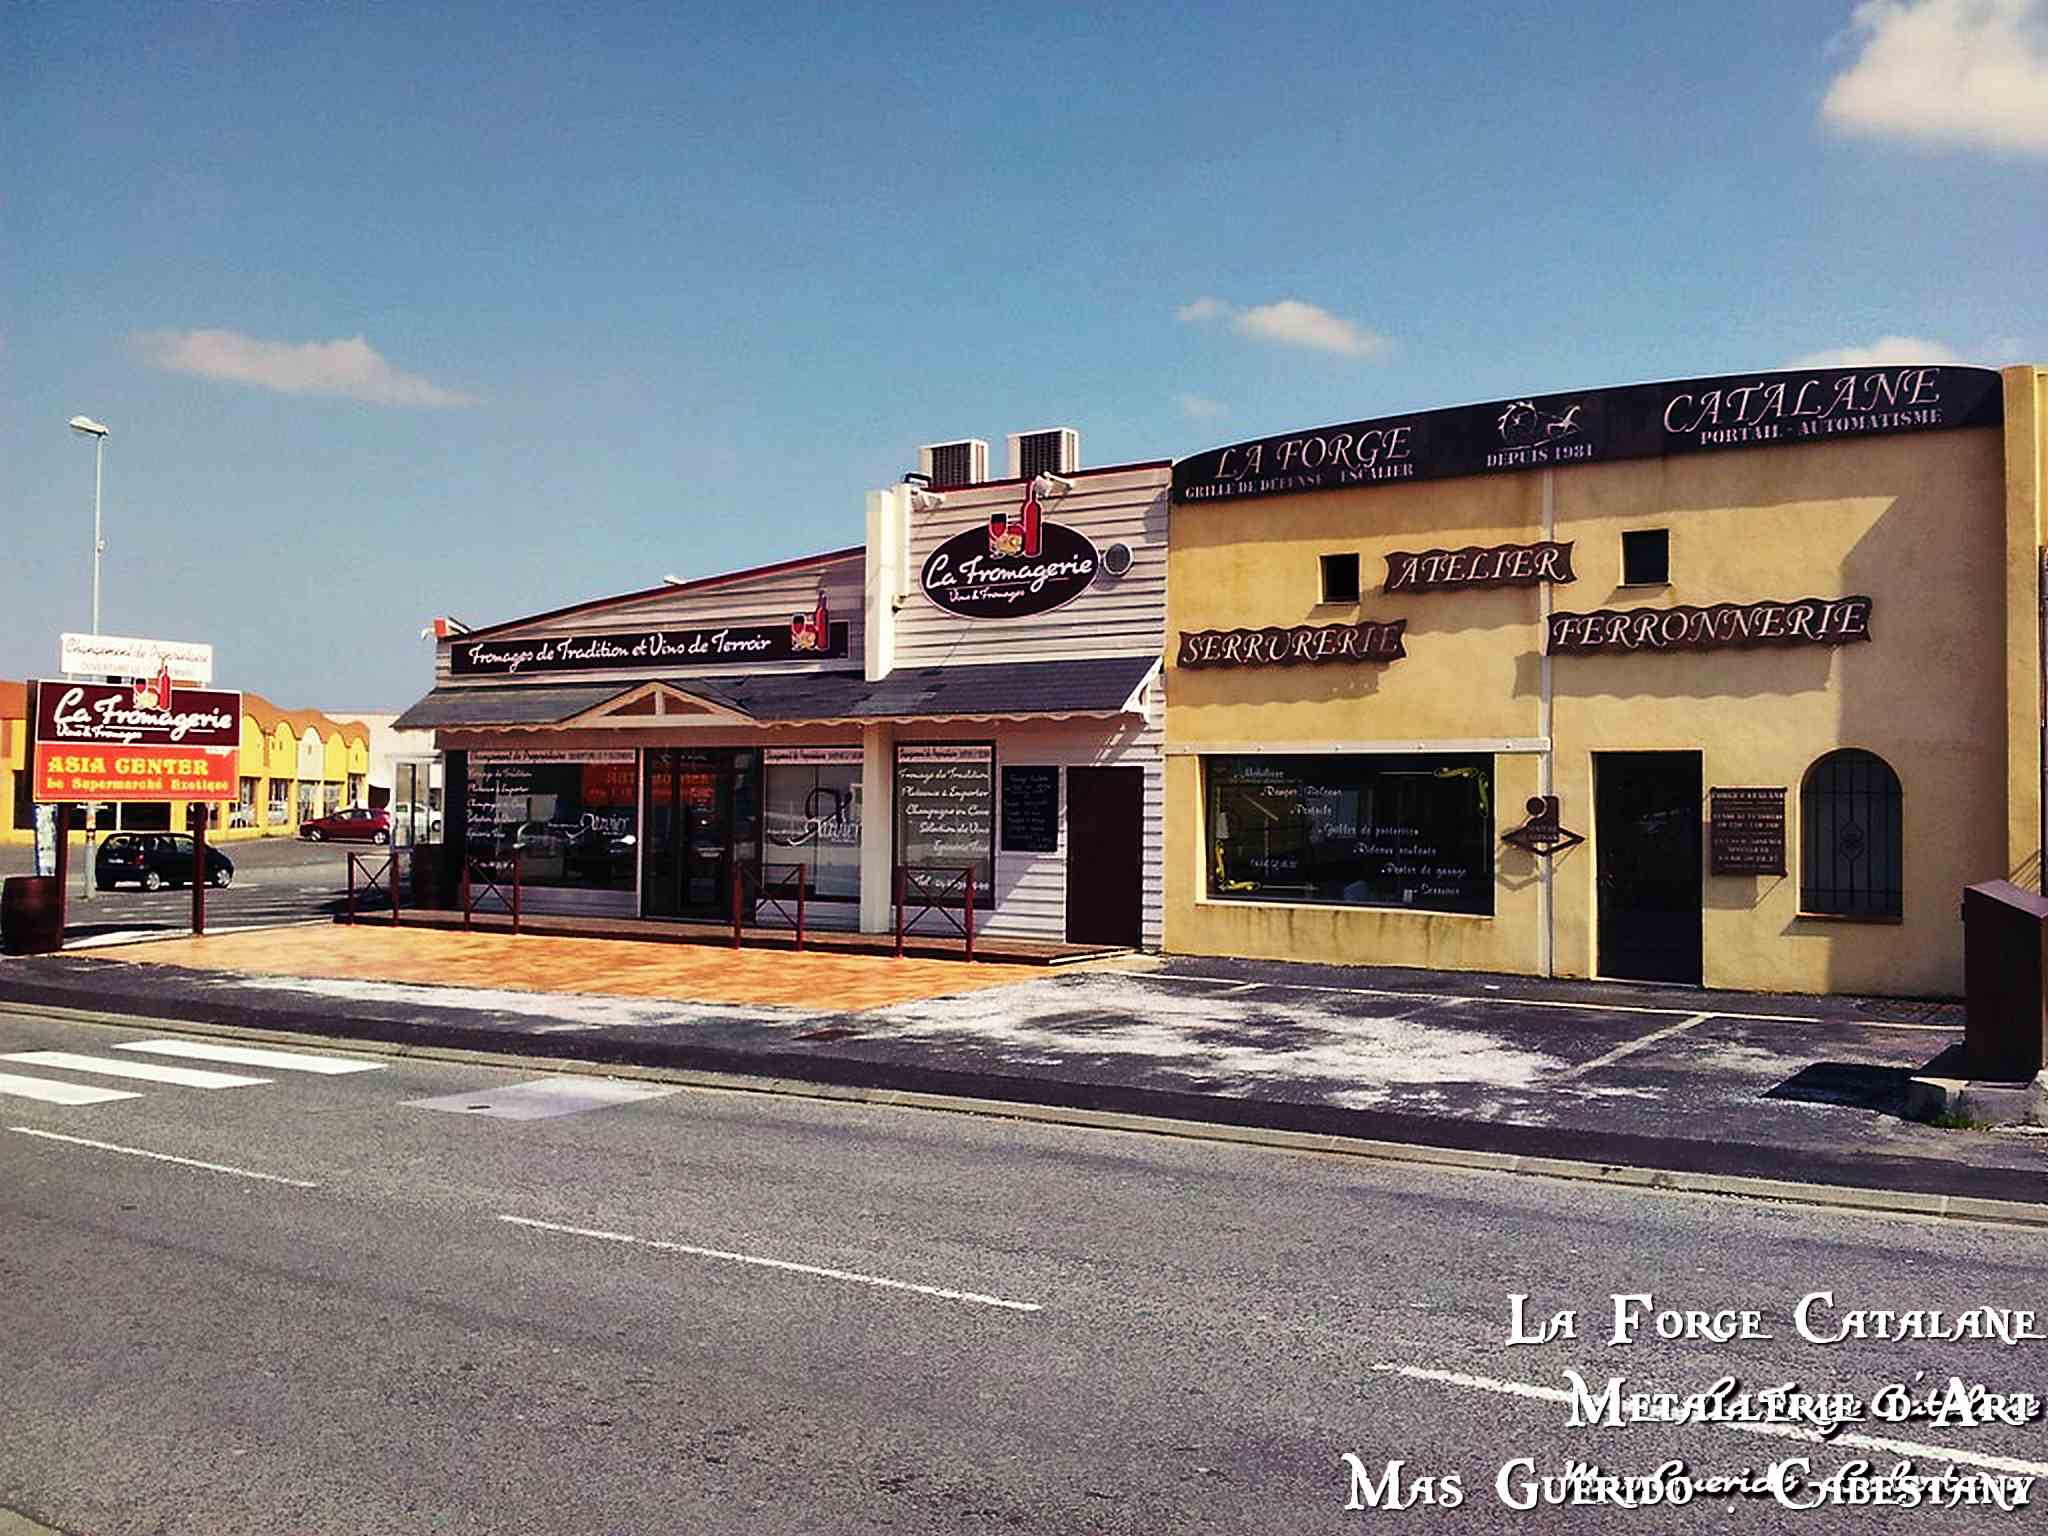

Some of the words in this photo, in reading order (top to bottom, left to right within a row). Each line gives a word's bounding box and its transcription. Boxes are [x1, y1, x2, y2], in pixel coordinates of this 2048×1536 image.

[1664, 367, 1941, 434] CATALANE
[1700, 424, 1783, 445] PORTAIL
[1799, 409, 1943, 436] AUTOMATISME
[1215, 444, 1264, 481] LA
[1276, 426, 1413, 471] FORGE
[1487, 448, 1549, 467] DEPUIS
[1555, 443, 1593, 460] 1981
[1185, 482, 1232, 498] GRILLE
[1238, 481, 1255, 494] DE
[1340, 463, 1414, 483] ESCALIER
[925, 554, 957, 589] La
[959, 554, 1093, 592] Fromagerie
[1393, 546, 1566, 590] ATELIER
[1182, 623, 1399, 665] SERRURERIE
[1552, 602, 1866, 649] FERRONNERIE
[468, 643, 534, 672] Fromages
[536, 642, 555, 662] de
[557, 637, 629, 660] Tradition
[632, 640, 648, 656] et
[649, 632, 685, 656] Vins
[688, 634, 709, 654] de
[711, 629, 772, 653] Terroir
[53, 687, 93, 723] La
[93, 694, 233, 742] Fromagerie
[48, 756, 107, 774] ASIA
